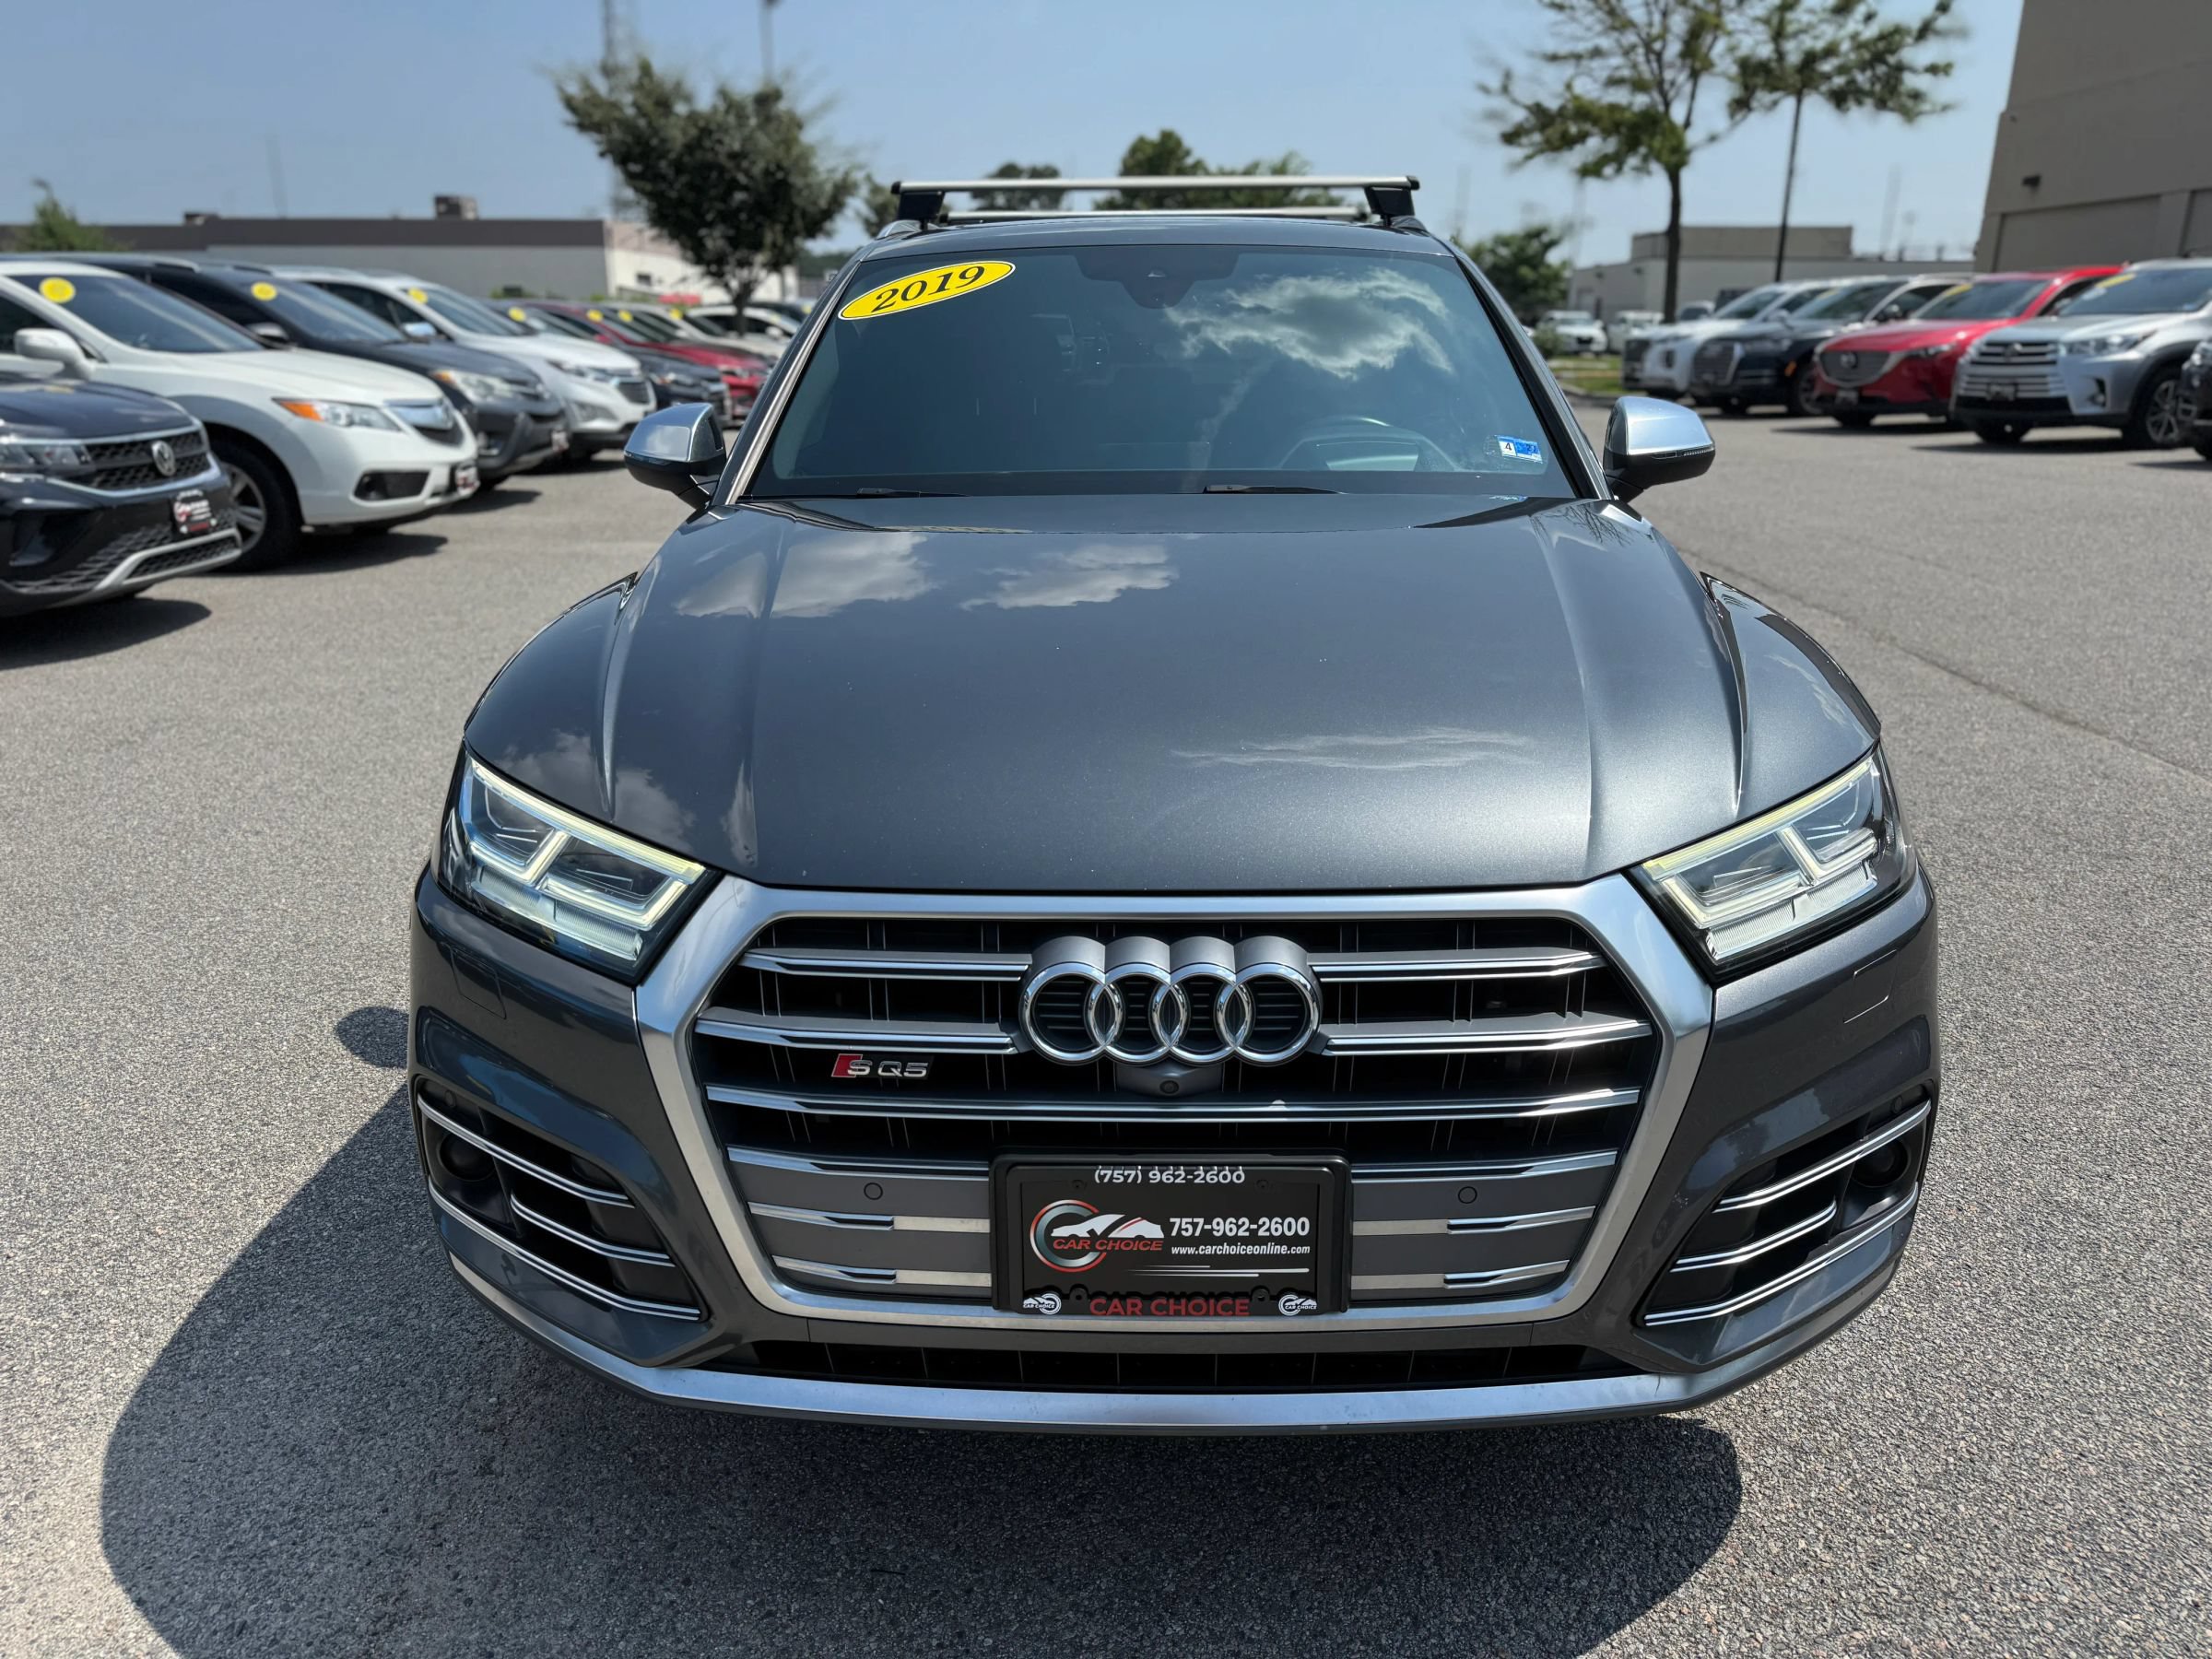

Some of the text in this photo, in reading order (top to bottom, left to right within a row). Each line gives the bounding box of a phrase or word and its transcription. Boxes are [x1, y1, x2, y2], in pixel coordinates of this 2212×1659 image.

[871, 265, 985, 313] 2019
[1094, 1169, 1245, 1183] (757) 962-2600
[1170, 1217, 1311, 1237] 757-962-2600
[1053, 1239, 1164, 1251] CAR CHOICE
[1171, 1242, 1311, 1255] www.carchoiceonline.com
[1089, 1298, 1250, 1316] CAR CHOICE
